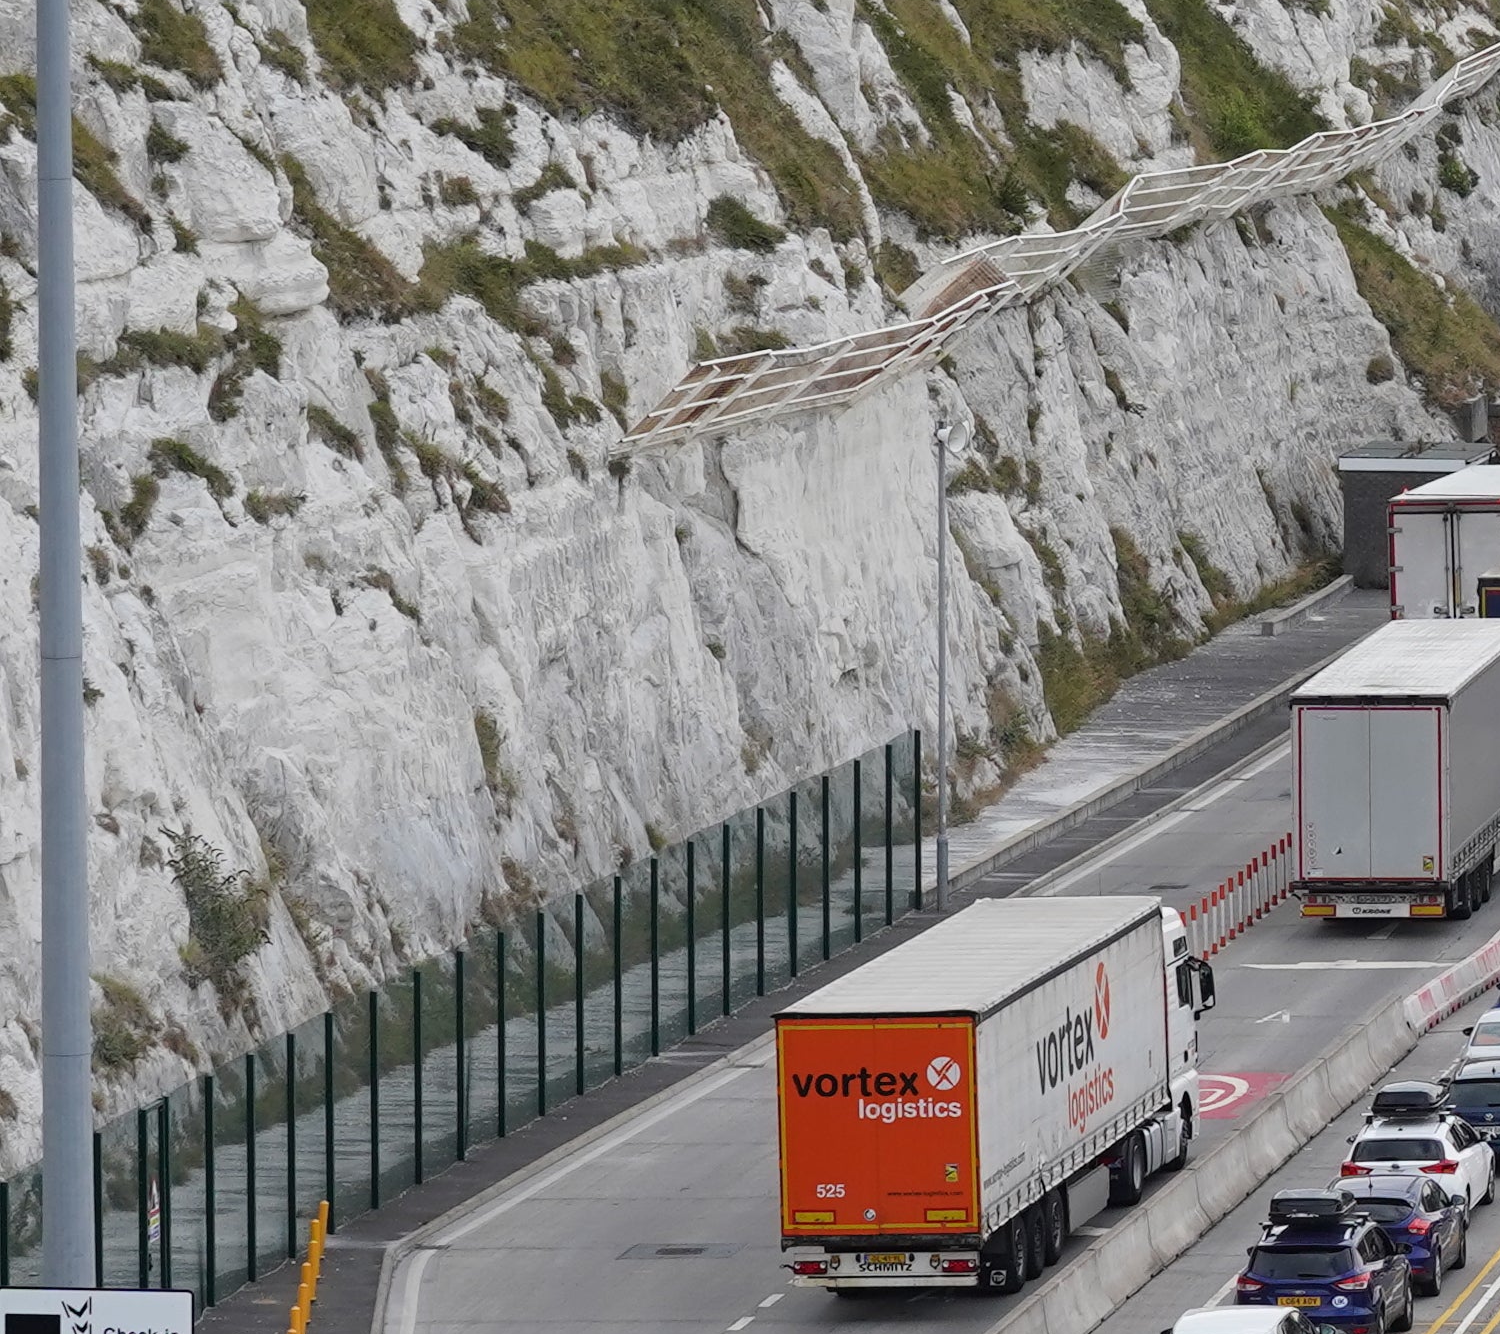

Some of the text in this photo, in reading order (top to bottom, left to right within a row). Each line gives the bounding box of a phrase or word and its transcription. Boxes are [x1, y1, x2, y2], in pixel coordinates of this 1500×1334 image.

[1361, 907, 1392, 915] KRONE
[1036, 1004, 1094, 1095] vortex
[792, 1071, 919, 1099] vortex
[1067, 1064, 1114, 1133] logistics
[856, 1097, 962, 1123] logistics
[815, 1183, 846, 1199] 525
[858, 1261, 913, 1273] SCHMITZ
[1334, 1298, 1346, 1306] UK
